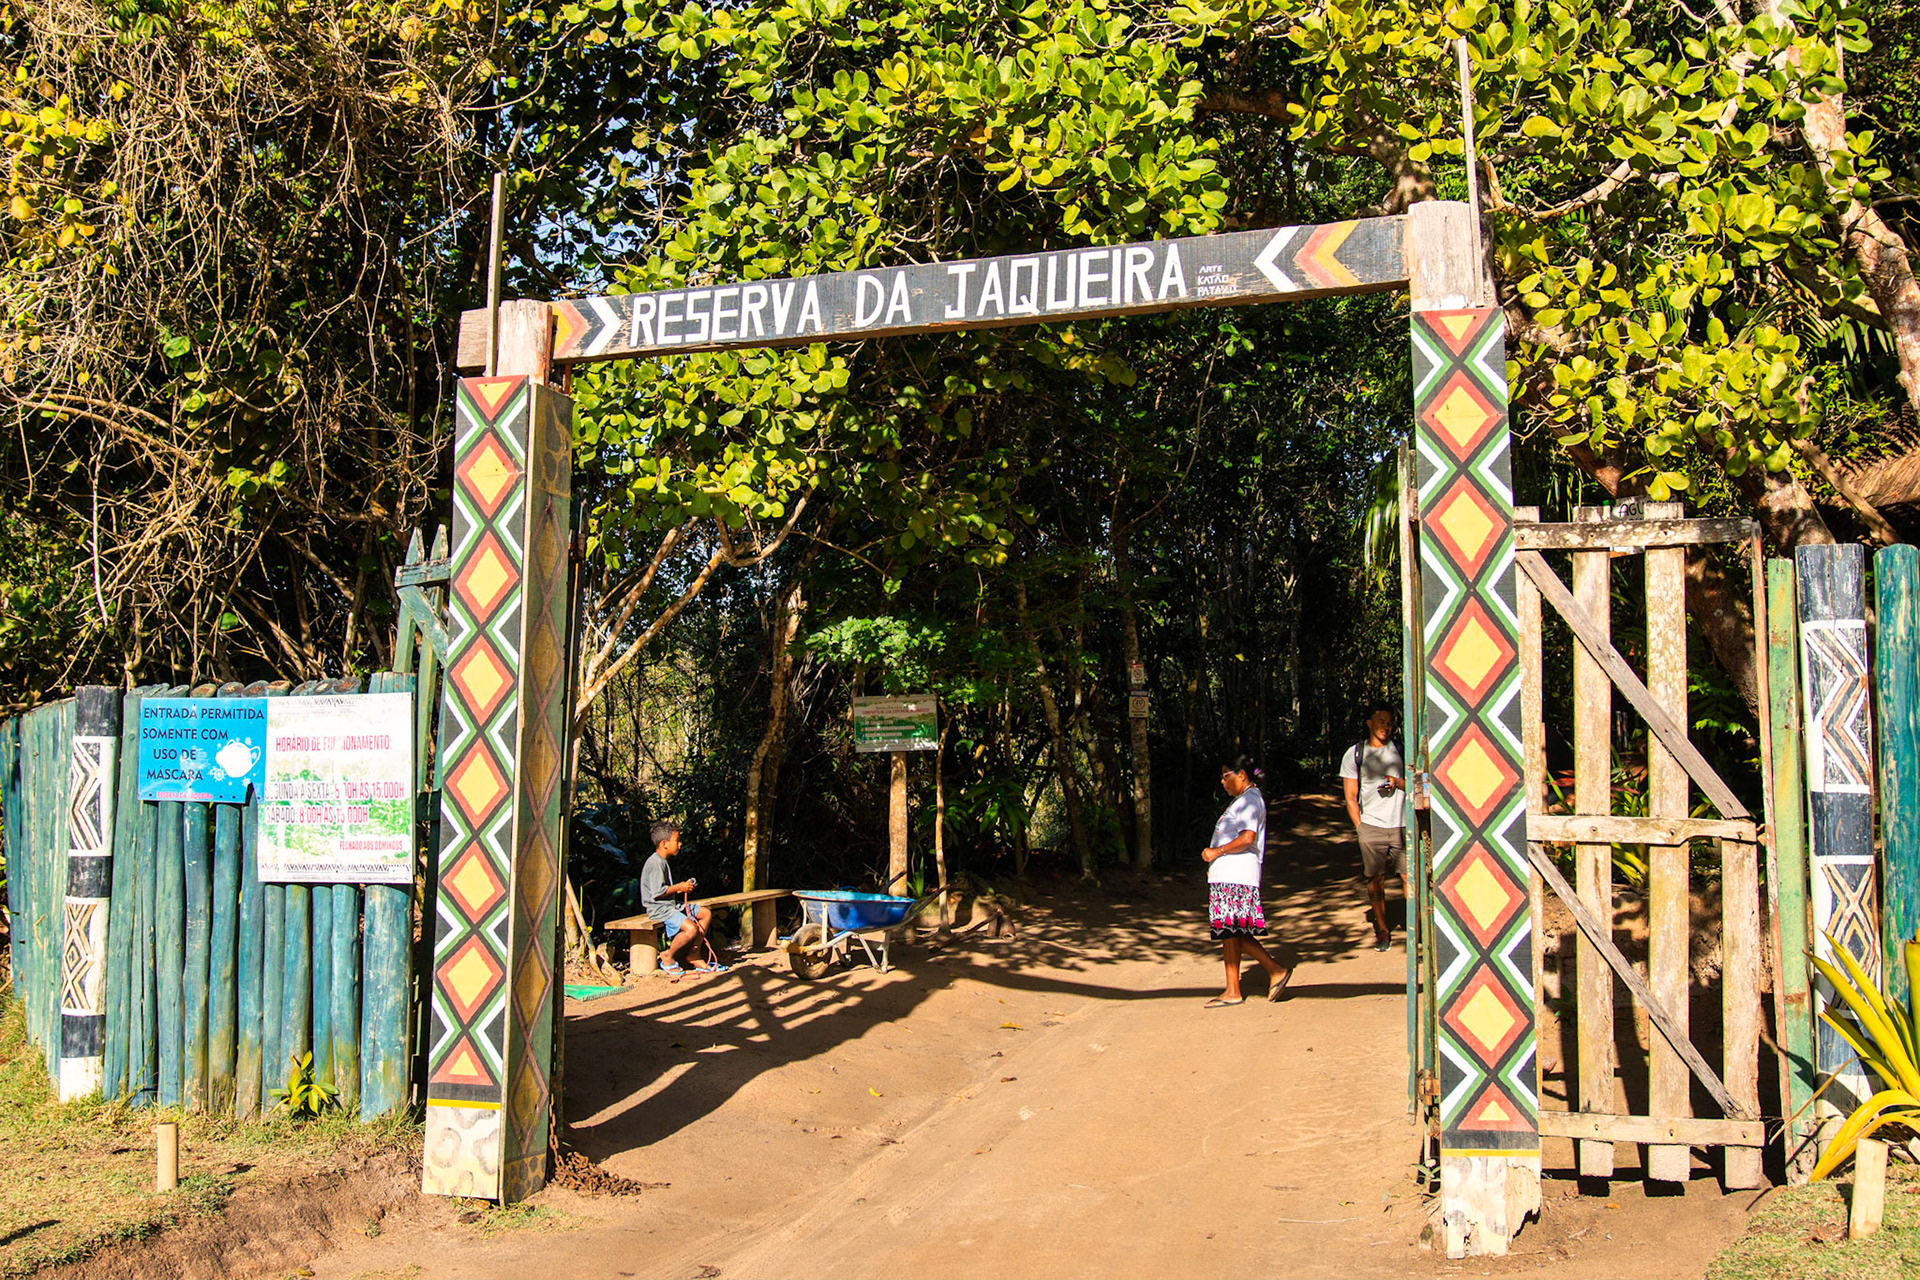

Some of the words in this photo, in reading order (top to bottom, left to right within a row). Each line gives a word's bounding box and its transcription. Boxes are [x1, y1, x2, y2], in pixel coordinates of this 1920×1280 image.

[1199, 264, 1223, 273] ARTE
[630, 280, 822, 348] RESERVA
[854, 270, 912, 328] DA
[944, 243, 1187, 319] JAQUEIRA
[144, 707, 198, 719] ENTRADA
[201, 708, 265, 720] PERMITIDA
[142, 727, 197, 740] SOMENTE
[200, 728, 229, 741] COM
[275, 733, 309, 752] HORÁRIO
[311, 736, 321, 752] DE
[153, 748, 178, 760] USO
[181, 749, 197, 760] DE
[146, 764, 204, 780] MÁSCARA
[300, 782, 307, 800] A
[374, 840, 403, 851] DOMINGOS
